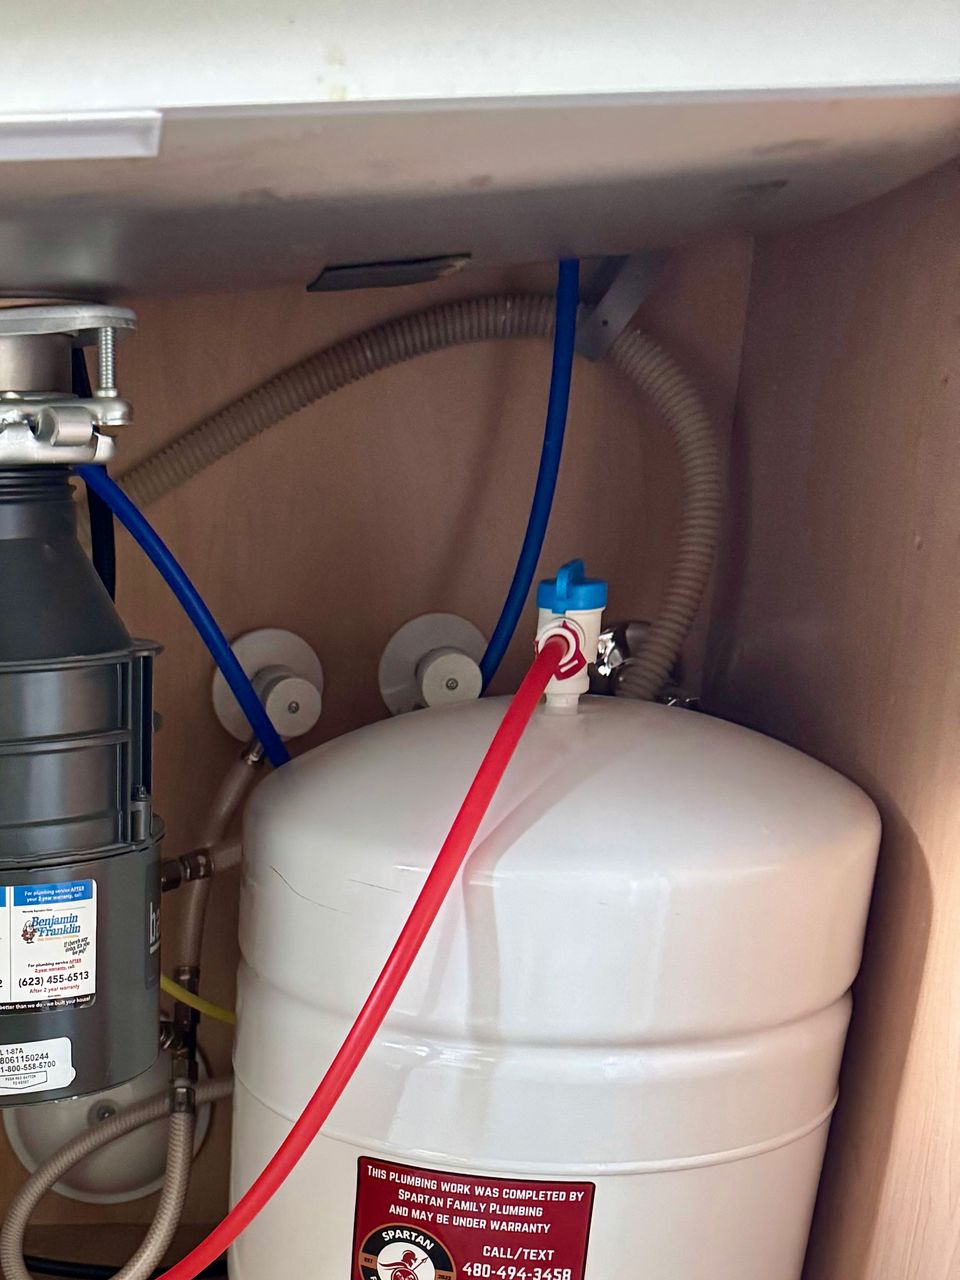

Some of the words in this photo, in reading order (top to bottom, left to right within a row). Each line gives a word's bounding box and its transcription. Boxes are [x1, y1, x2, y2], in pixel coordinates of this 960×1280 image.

[32, 913, 78, 928] Benjamin
[37, 924, 81, 937] Franklin
[19, 977, 44, 988] (623)
[47, 971, 89, 984] 455-6513
[1, 1060, 56, 1073] 1-800-558-5700
[367, 1165, 386, 1180] THIS
[389, 1172, 437, 1190] PLUMBING
[440, 1181, 471, 1195] WORK
[474, 1186, 499, 1198] WAS
[502, 1188, 566, 1201] COMPLETED
[569, 1191, 584, 1201] BY
[398, 1189, 444, 1208] SPARTAN
[447, 1198, 487, 1212] FAMILY
[489, 1203, 543, 1217] PLUMBING
[389, 1204, 409, 1217] AND
[411, 1208, 434, 1222] MAY
[436, 1214, 449, 1225] BE
[452, 1216, 486, 1229] UNDER
[490, 1220, 551, 1234] WARRANTY
[382, 1230, 434, 1250] SPARTAN
[483, 1245, 555, 1261] CALL/TEXT
